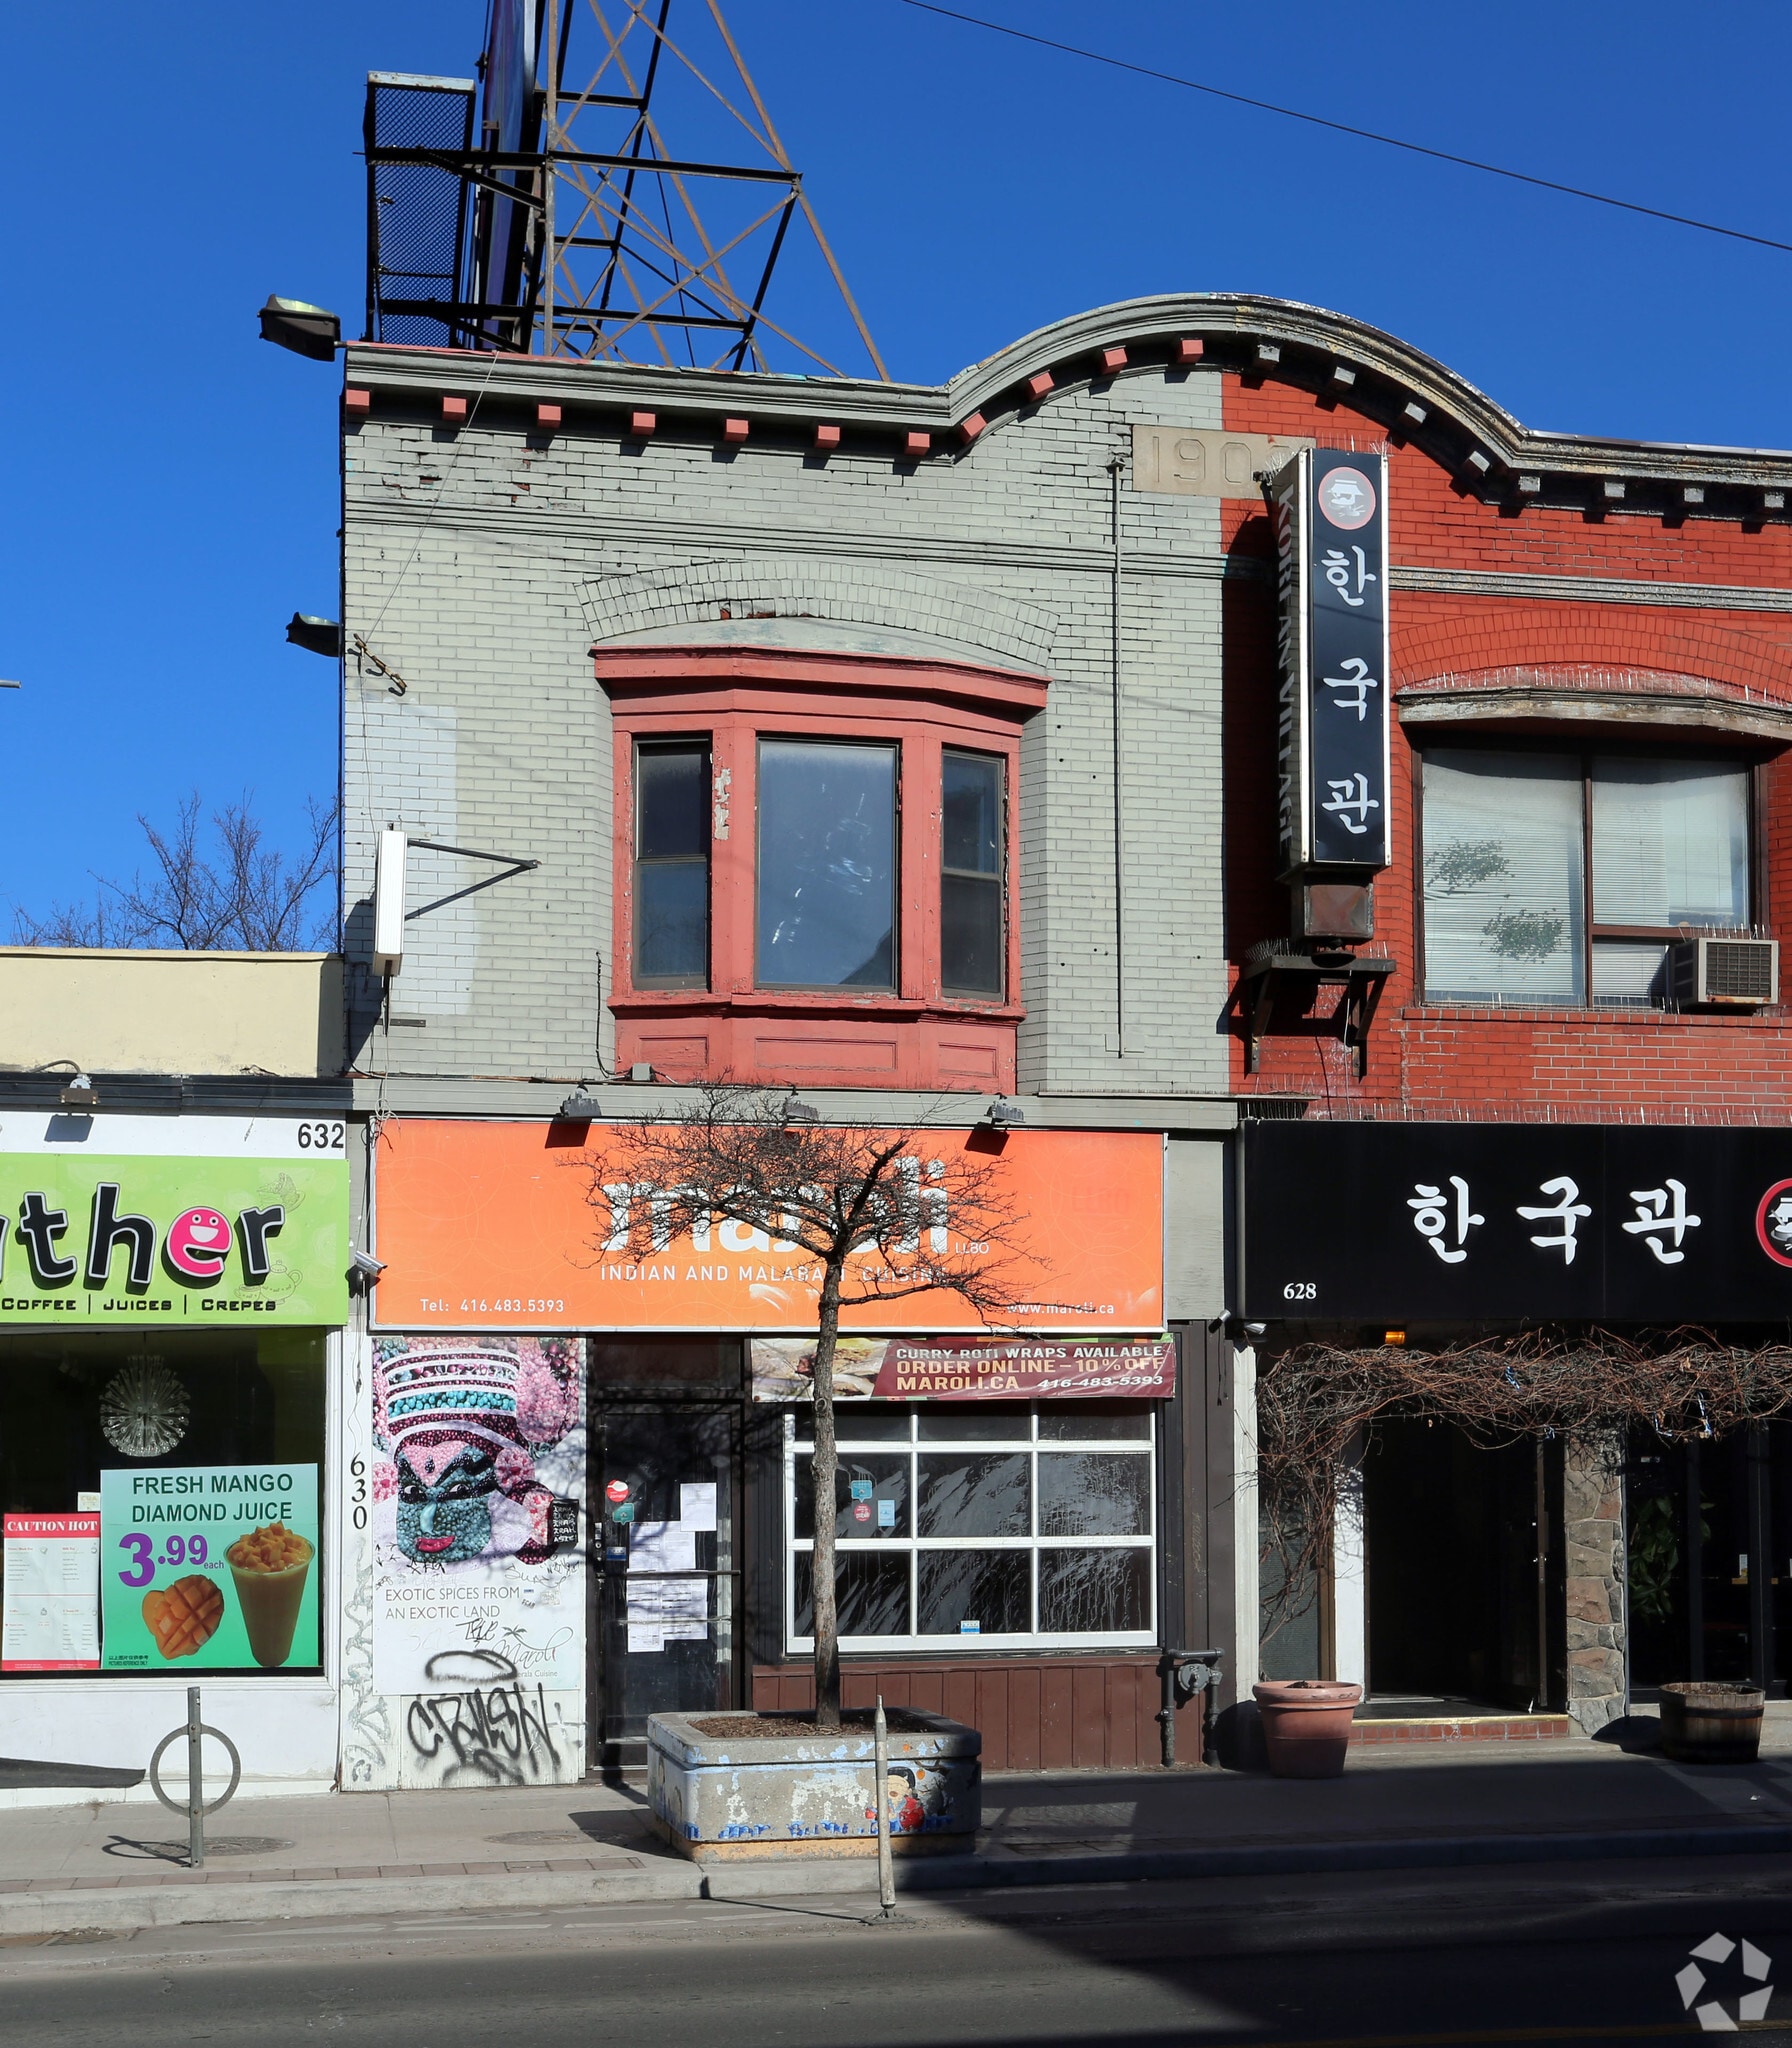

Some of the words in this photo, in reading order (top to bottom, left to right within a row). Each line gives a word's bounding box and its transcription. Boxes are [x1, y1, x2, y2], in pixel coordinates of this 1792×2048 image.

[1152, 436, 1291, 484] 190
[297, 1122, 345, 1150] 632
[0, 1182, 285, 1284] ther
[600, 1265, 676, 1281] INDIAN
[685, 1265, 728, 1281] AND
[738, 1265, 846, 1282] MALABA
[1283, 1282, 1317, 1300] 628
[1, 1298, 77, 1312] COFFEE
[103, 1298, 172, 1312] JUICES
[201, 1298, 276, 1312] CREPES
[420, 1298, 449, 1312] Tel:
[460, 1299, 565, 1313] 416.483.5393
[896, 1348, 953, 1360] CURRY
[960, 1348, 998, 1359] ROTI
[1005, 1347, 1067, 1359] WRAPS
[1073, 1346, 1164, 1358] AVAILABLE
[896, 1360, 970, 1374] ORDER
[977, 1360, 1056, 1374] ONLINE
[1124, 1357, 1165, 1371] OFF
[896, 1376, 1019, 1391] MAROLI.CA
[1036, 1375, 1165, 1389] 416-483-5393
[132, 1476, 204, 1494] FRESH
[211, 1473, 293, 1493] MANGO
[131, 1503, 227, 1523] DIAMOND
[233, 1502, 293, 1520] JUICE
[7, 1521, 65, 1532] CAUTION
[68, 1521, 98, 1531] HOT
[118, 1532, 208, 1588] 3.99
[203, 1559, 225, 1569] each
[385, 1587, 436, 1601] EXOTIC
[439, 1587, 480, 1600] SPICES
[483, 1586, 520, 1600] FROM
[385, 1607, 406, 1620] AN
[409, 1606, 460, 1620] EXOTIC
[463, 1605, 501, 1618] LAND
